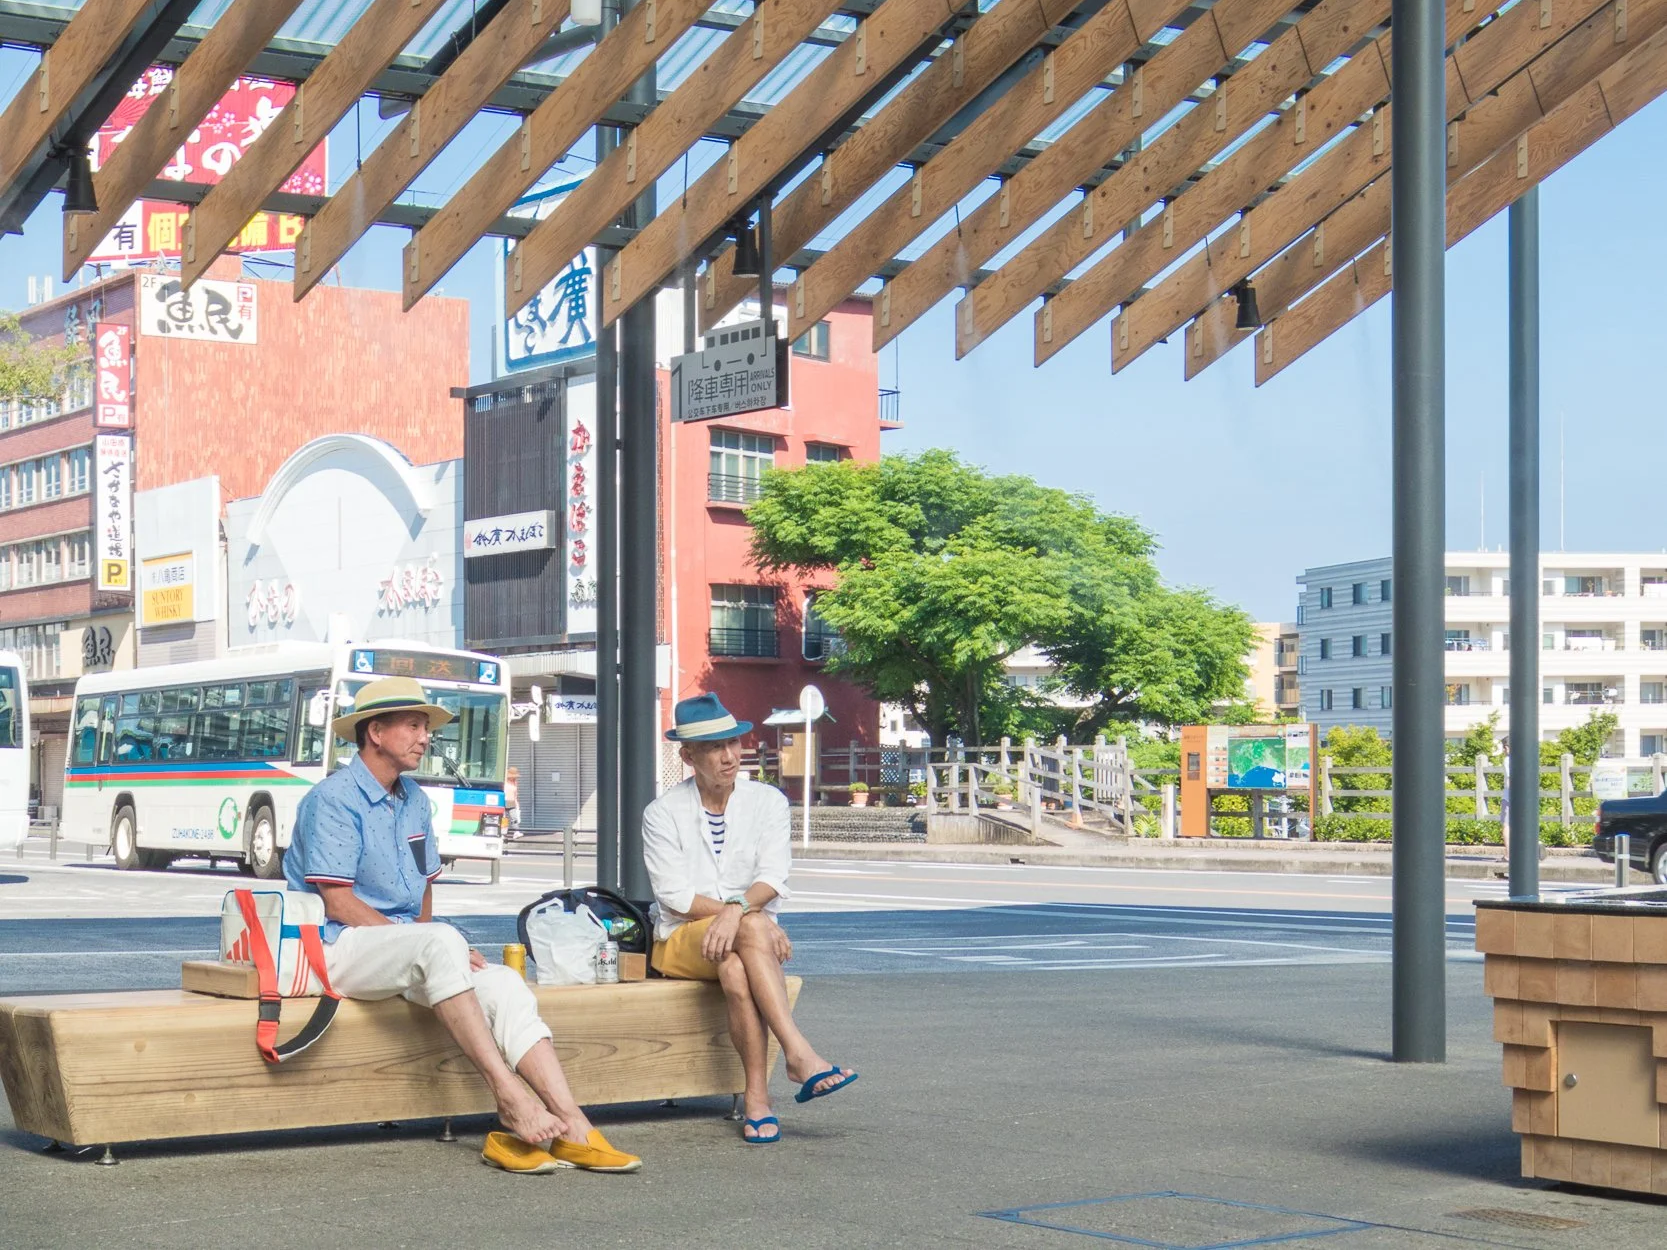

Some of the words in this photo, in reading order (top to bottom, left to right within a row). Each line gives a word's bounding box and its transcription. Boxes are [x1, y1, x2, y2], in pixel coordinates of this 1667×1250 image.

[142, 276, 156, 289] 2F
[155, 279, 244, 341] 魚民
[116, 326, 129, 336] 2F
[98, 330, 128, 403] 魚民
[749, 367, 775, 382] ARRIVALS
[687, 369, 749, 406] 降車専用
[750, 381, 773, 393] ONLY
[107, 562, 122, 583] P
[151, 588, 184, 606] SUNTORY
[155, 603, 182, 619] WHISKY
